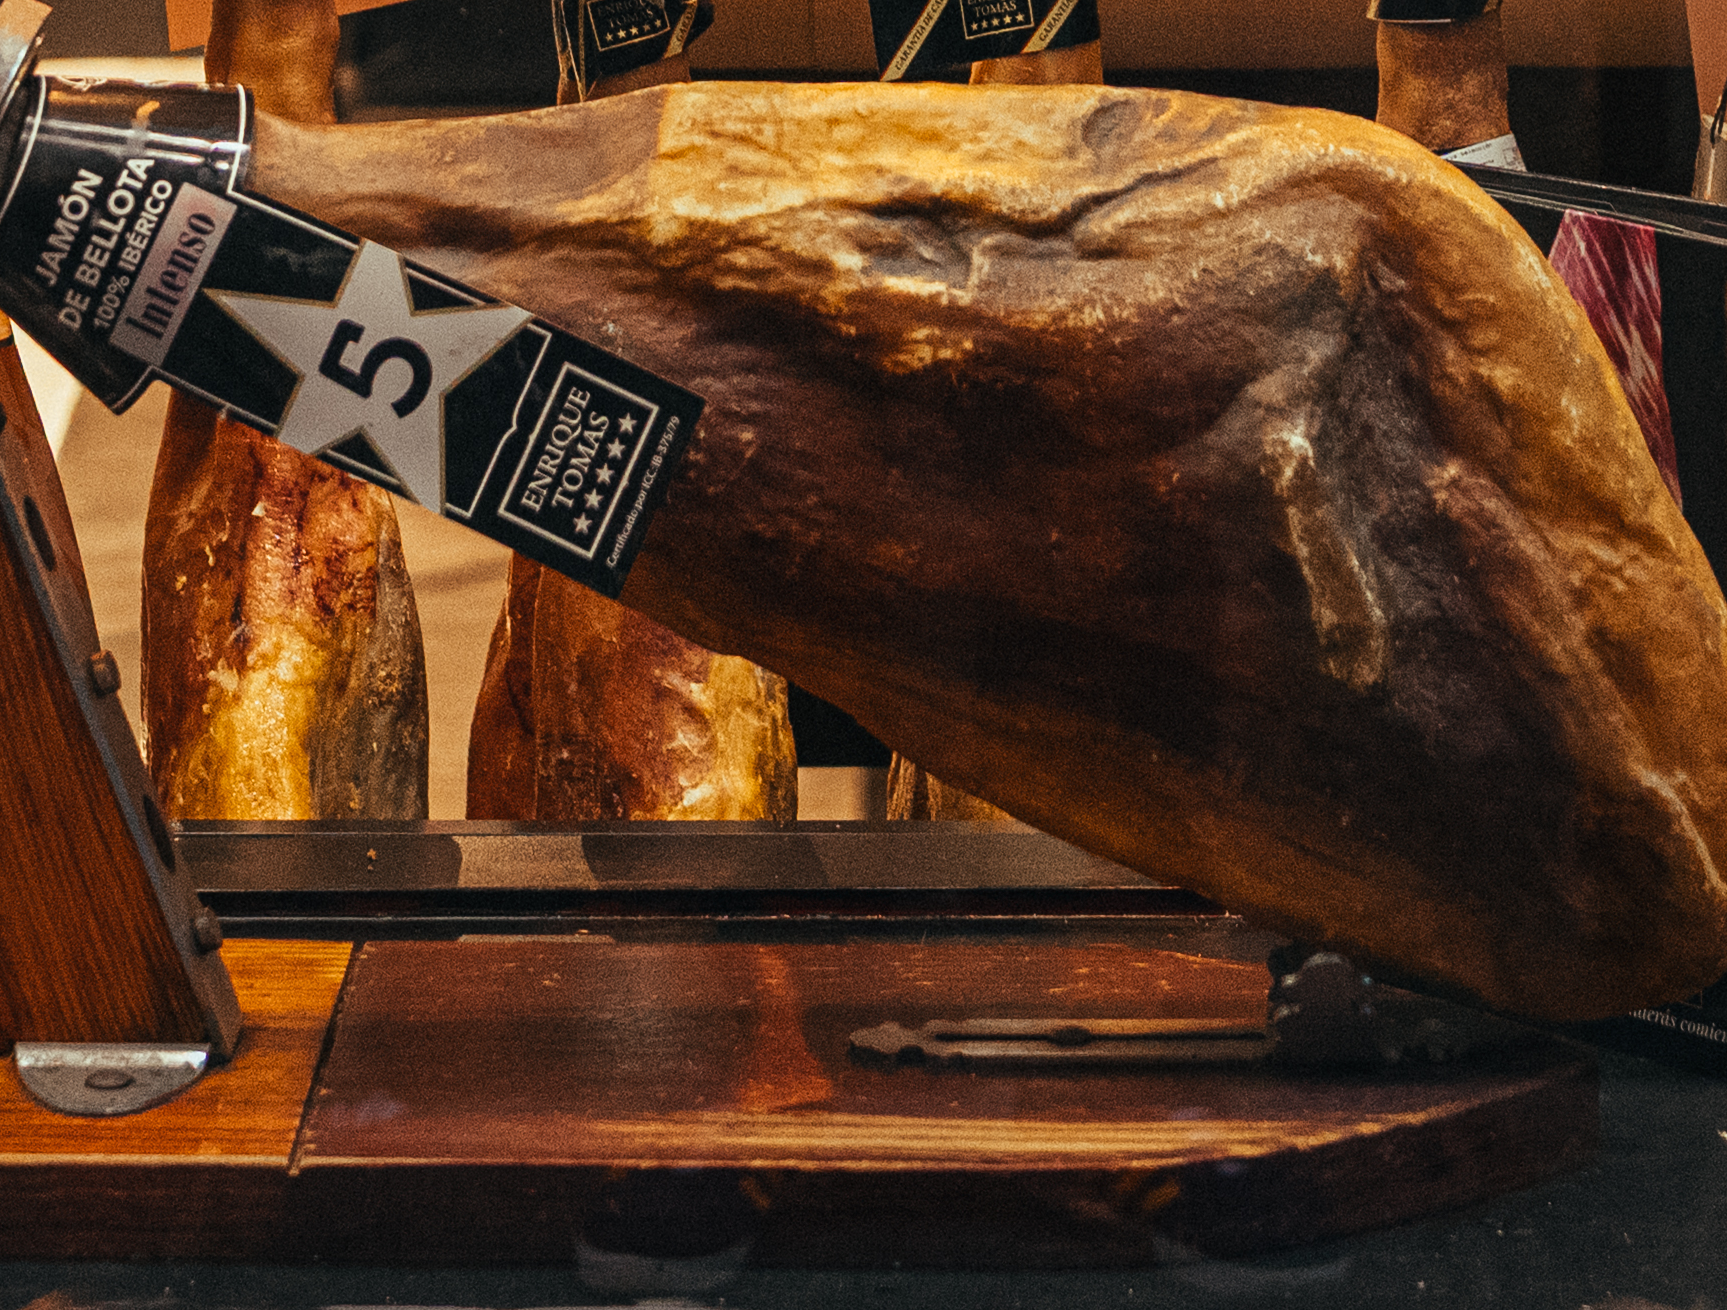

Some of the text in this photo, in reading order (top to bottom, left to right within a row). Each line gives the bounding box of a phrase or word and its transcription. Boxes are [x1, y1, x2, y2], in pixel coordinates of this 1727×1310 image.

[35, 167, 104, 286] JAMÓN
[58, 157, 156, 330] DE BELLOTA
[93, 178, 173, 330] 100% IBÉRICO
[124, 211, 217, 341] Intenso
[318, 318, 434, 419] 5
[519, 385, 592, 513] ENRIQUE
[605, 506, 639, 568] Certificado
[633, 487, 648, 513] por
